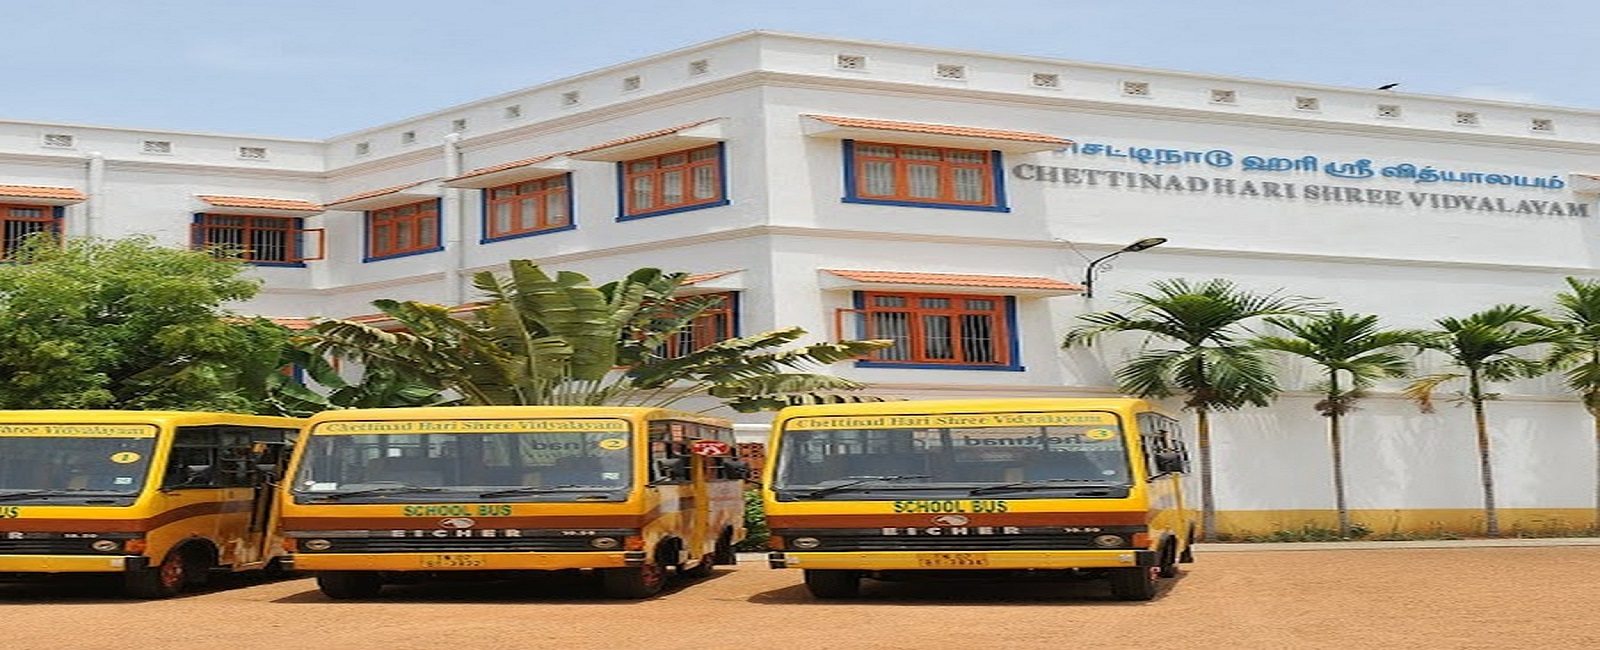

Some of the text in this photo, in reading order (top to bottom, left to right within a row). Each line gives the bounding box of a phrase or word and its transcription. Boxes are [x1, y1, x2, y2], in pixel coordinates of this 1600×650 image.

[1242, 154, 1318, 172] ஹரி
[1381, 163, 1565, 190] வித்யாலயம்
[1012, 163, 1590, 218] CHETTINAD HARI SHREE VIDYALAYAM
[326, 419, 623, 432] Chettinad Hari Shree Vidyalayam
[796, 414, 1101, 428] Chettinad Hari Shree Vidyalayam
[0, 425, 144, 437] hree Vidyalayam
[0, 507, 19, 519] US
[404, 505, 512, 516] SCHOOL BUS
[893, 501, 1008, 513] SCHOOL BUS
[391, 529, 521, 537] EICHER
[881, 527, 1020, 535] EICHER
